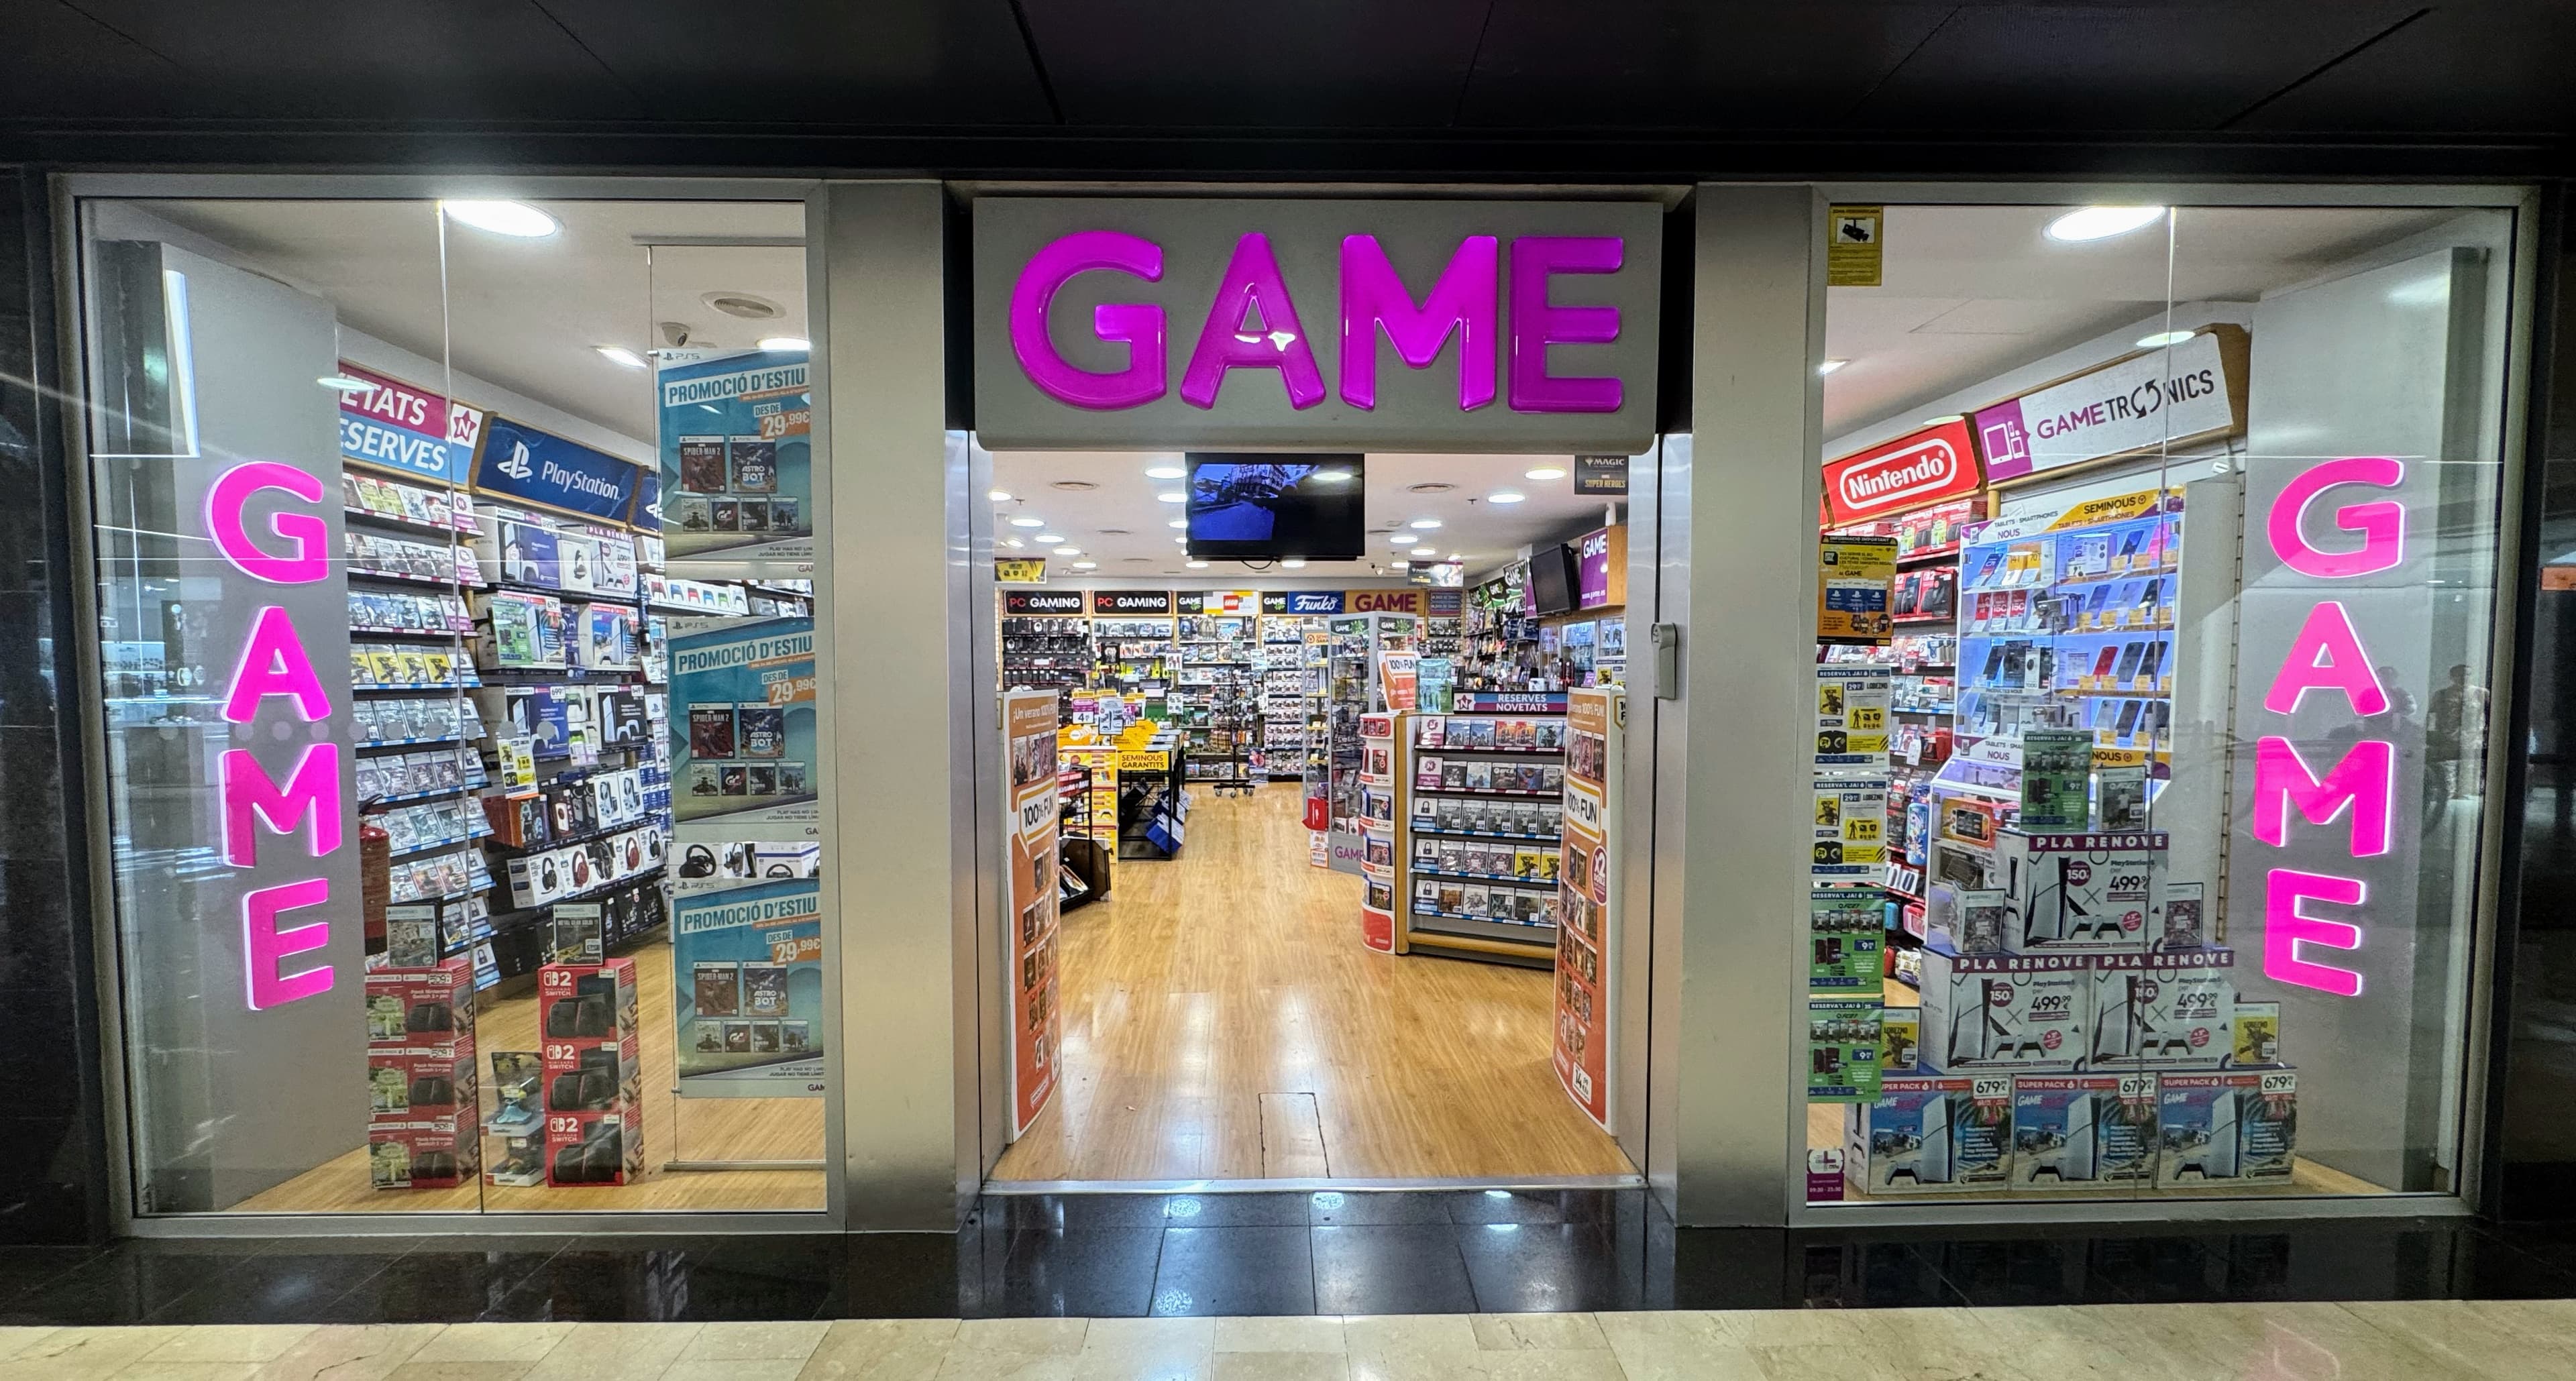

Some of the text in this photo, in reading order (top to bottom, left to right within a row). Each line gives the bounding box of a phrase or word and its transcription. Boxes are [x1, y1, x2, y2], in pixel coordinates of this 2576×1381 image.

[1008, 230, 1624, 412] GAME
[669, 373, 747, 404] PROMOCIÓ
[751, 368, 806, 390] D'ESTIU
[338, 372, 428, 425] ETATS
[542, 460, 620, 501] PlayStation
[742, 473, 765, 482] BOT
[1848, 456, 1945, 500] Nintendo
[2084, 496, 2136, 514] SEMINOUS
[1997, 529, 2021, 539] NOUS
[1583, 534, 1606, 559] GAME
[1010, 597, 1081, 608] PC GAMING
[1097, 597, 1167, 608] PC GAMING
[1179, 597, 1202, 605] GAME
[1264, 597, 1286, 606] GAME
[1294, 595, 1337, 612] Funko
[1355, 593, 1417, 612] GAME
[1336, 624, 1350, 632] GAME
[679, 641, 757, 671] PROMOCIÓ
[759, 637, 812, 659] D'ESTIU
[1404, 659, 1415, 669] FUN
[1498, 694, 1546, 702] RESERVES
[1496, 703, 1548, 712] NOVETATS
[2253, 457, 2405, 997] GAME
[205, 461, 342, 1011] GAME
[750, 738, 773, 747] BOT
[1987, 751, 2010, 761] NOUS
[1580, 795, 1597, 825] FUN
[2037, 836, 2072, 848] PLA
[684, 903, 760, 931] PROMOCIÓ
[764, 897, 816, 920] D'ESTIU
[1960, 956, 2084, 970] PLA RENOVE
[2104, 952, 2229, 966] PLA RENOVE
[754, 997, 776, 1005] BOT
[2017, 1081, 2066, 1089] SUPER PACK
[2163, 1078, 2210, 1087] SUPER PACK
[2018, 1095, 2043, 1107] GAME
